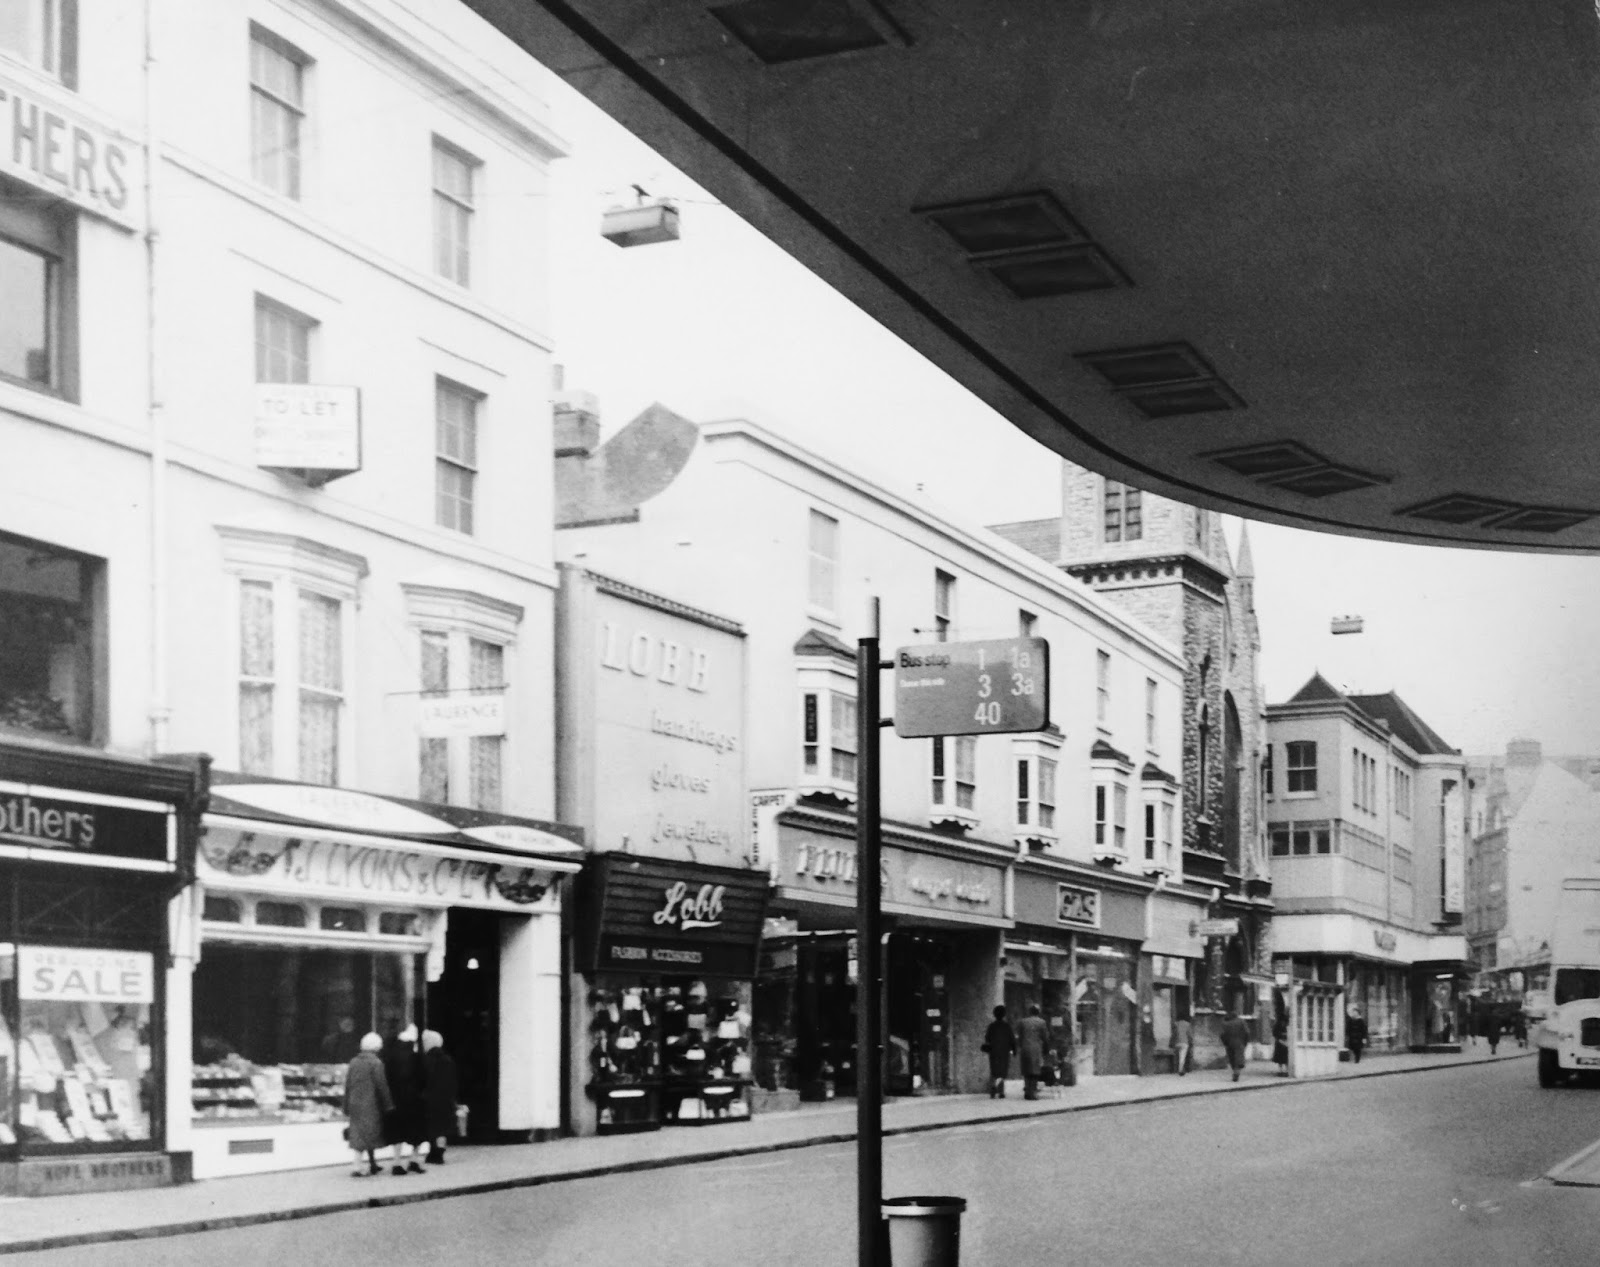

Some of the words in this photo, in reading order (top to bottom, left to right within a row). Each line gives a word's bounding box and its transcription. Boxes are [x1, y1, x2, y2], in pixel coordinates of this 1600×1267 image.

[0, 89, 127, 210] HERS
[263, 399, 289, 414] TO
[300, 401, 339, 416] LET
[900, 652, 922, 668] Bus
[924, 654, 951, 669] stop
[977, 648, 985, 670] 1
[1010, 646, 1031, 669] 1a
[977, 674, 992, 698] 3
[1010, 672, 1035, 696] 3a
[974, 701, 1001, 725] 40
[651, 711, 735, 755] handbags
[651, 763, 710, 793] gloves
[651, 813, 729, 853] jewellery
[325, 843, 419, 892] LYONS
[652, 881, 726, 926] Lobb
[32, 967, 142, 996] SALE
